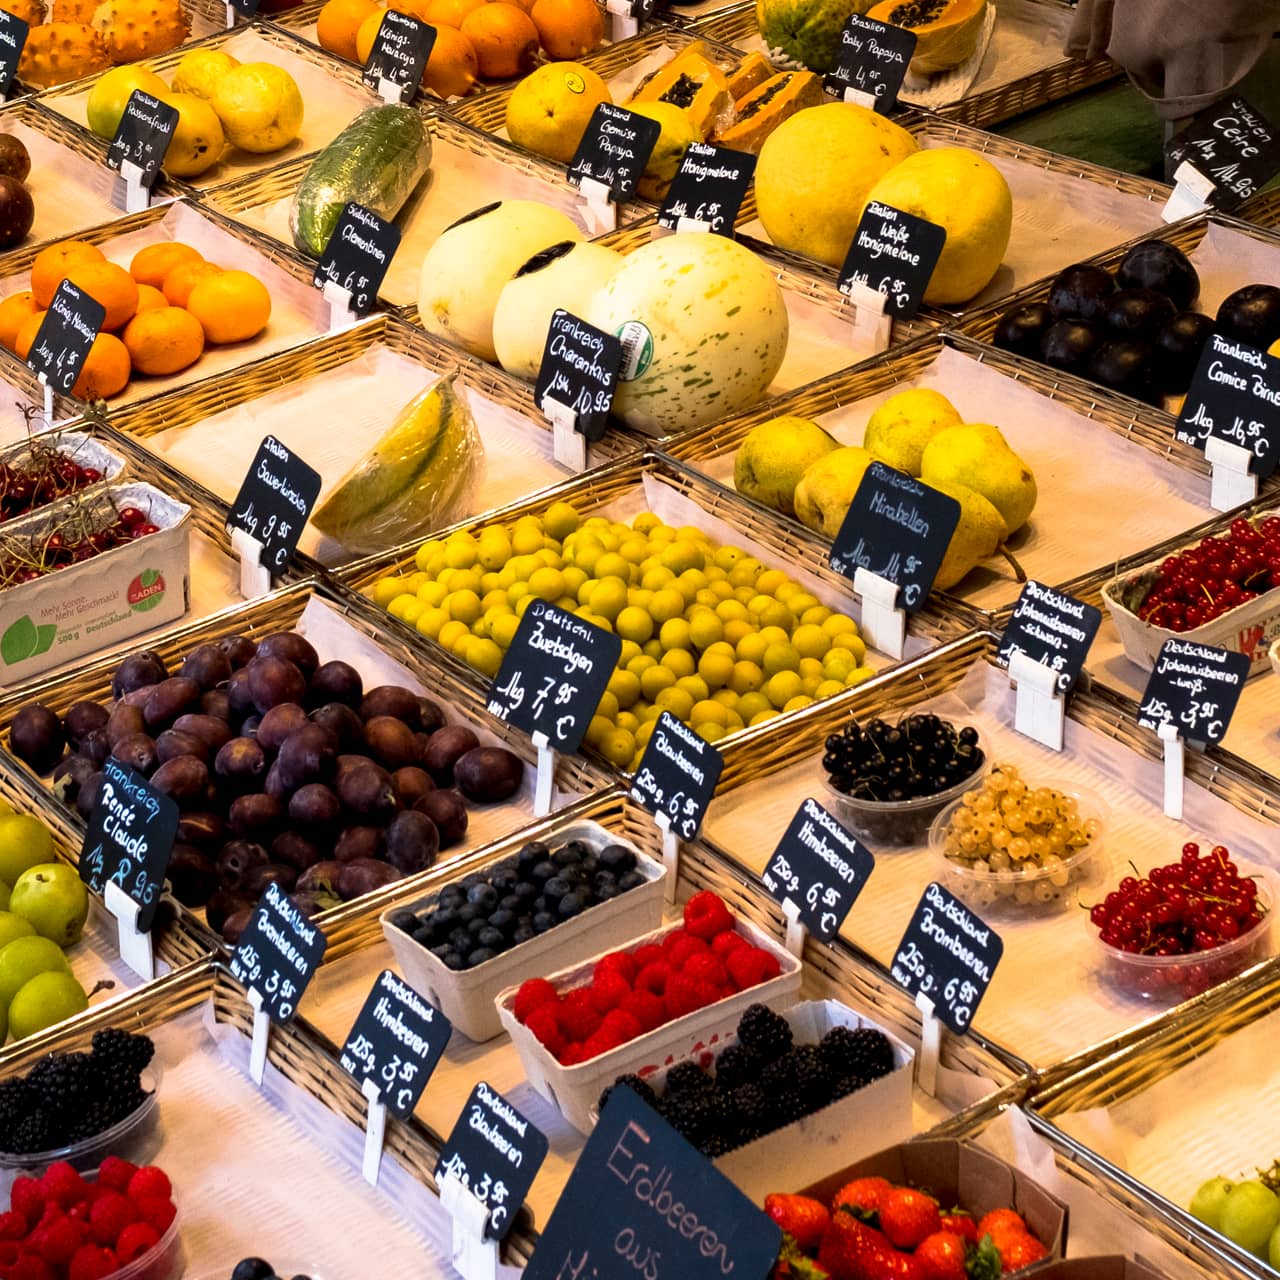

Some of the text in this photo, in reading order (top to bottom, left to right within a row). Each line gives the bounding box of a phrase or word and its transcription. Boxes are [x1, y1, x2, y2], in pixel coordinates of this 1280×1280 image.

[842, 31, 903, 63] Baby Papaya
[598, 135, 634, 160] Papaya
[681, 159, 738, 183] Honigmelone
[858, 231, 919, 266] Honigmelone
[552, 310, 603, 359] Frankreich
[1213, 334, 1266, 371] Frankreich
[1185, 403, 1213, 439] 1kg
[236, 502, 257, 536] 1kg
[869, 491, 929, 538] Mirabellen
[1025, 580, 1083, 619] Deutschland
[528, 622, 592, 675] Zwetschgen
[1163, 638, 1226, 663] Deutschland
[496, 672, 523, 710] 1kg
[556, 715, 574, 739] €
[660, 711, 704, 754] Deutschland
[654, 730, 703, 785] Blaubeeren
[804, 798, 856, 854] Deutschland
[797, 820, 855, 884] Himbeeren
[925, 882, 988, 949] Deutschland
[919, 907, 989, 983] Brombeeren
[380, 970, 433, 1023] Deutschland
[372, 996, 429, 1059] Himbeeren
[476, 1081, 528, 1137] Deutschland
[469, 1104, 523, 1168] Blaubeeren
[607, 1121, 735, 1274] Erdbeeren
